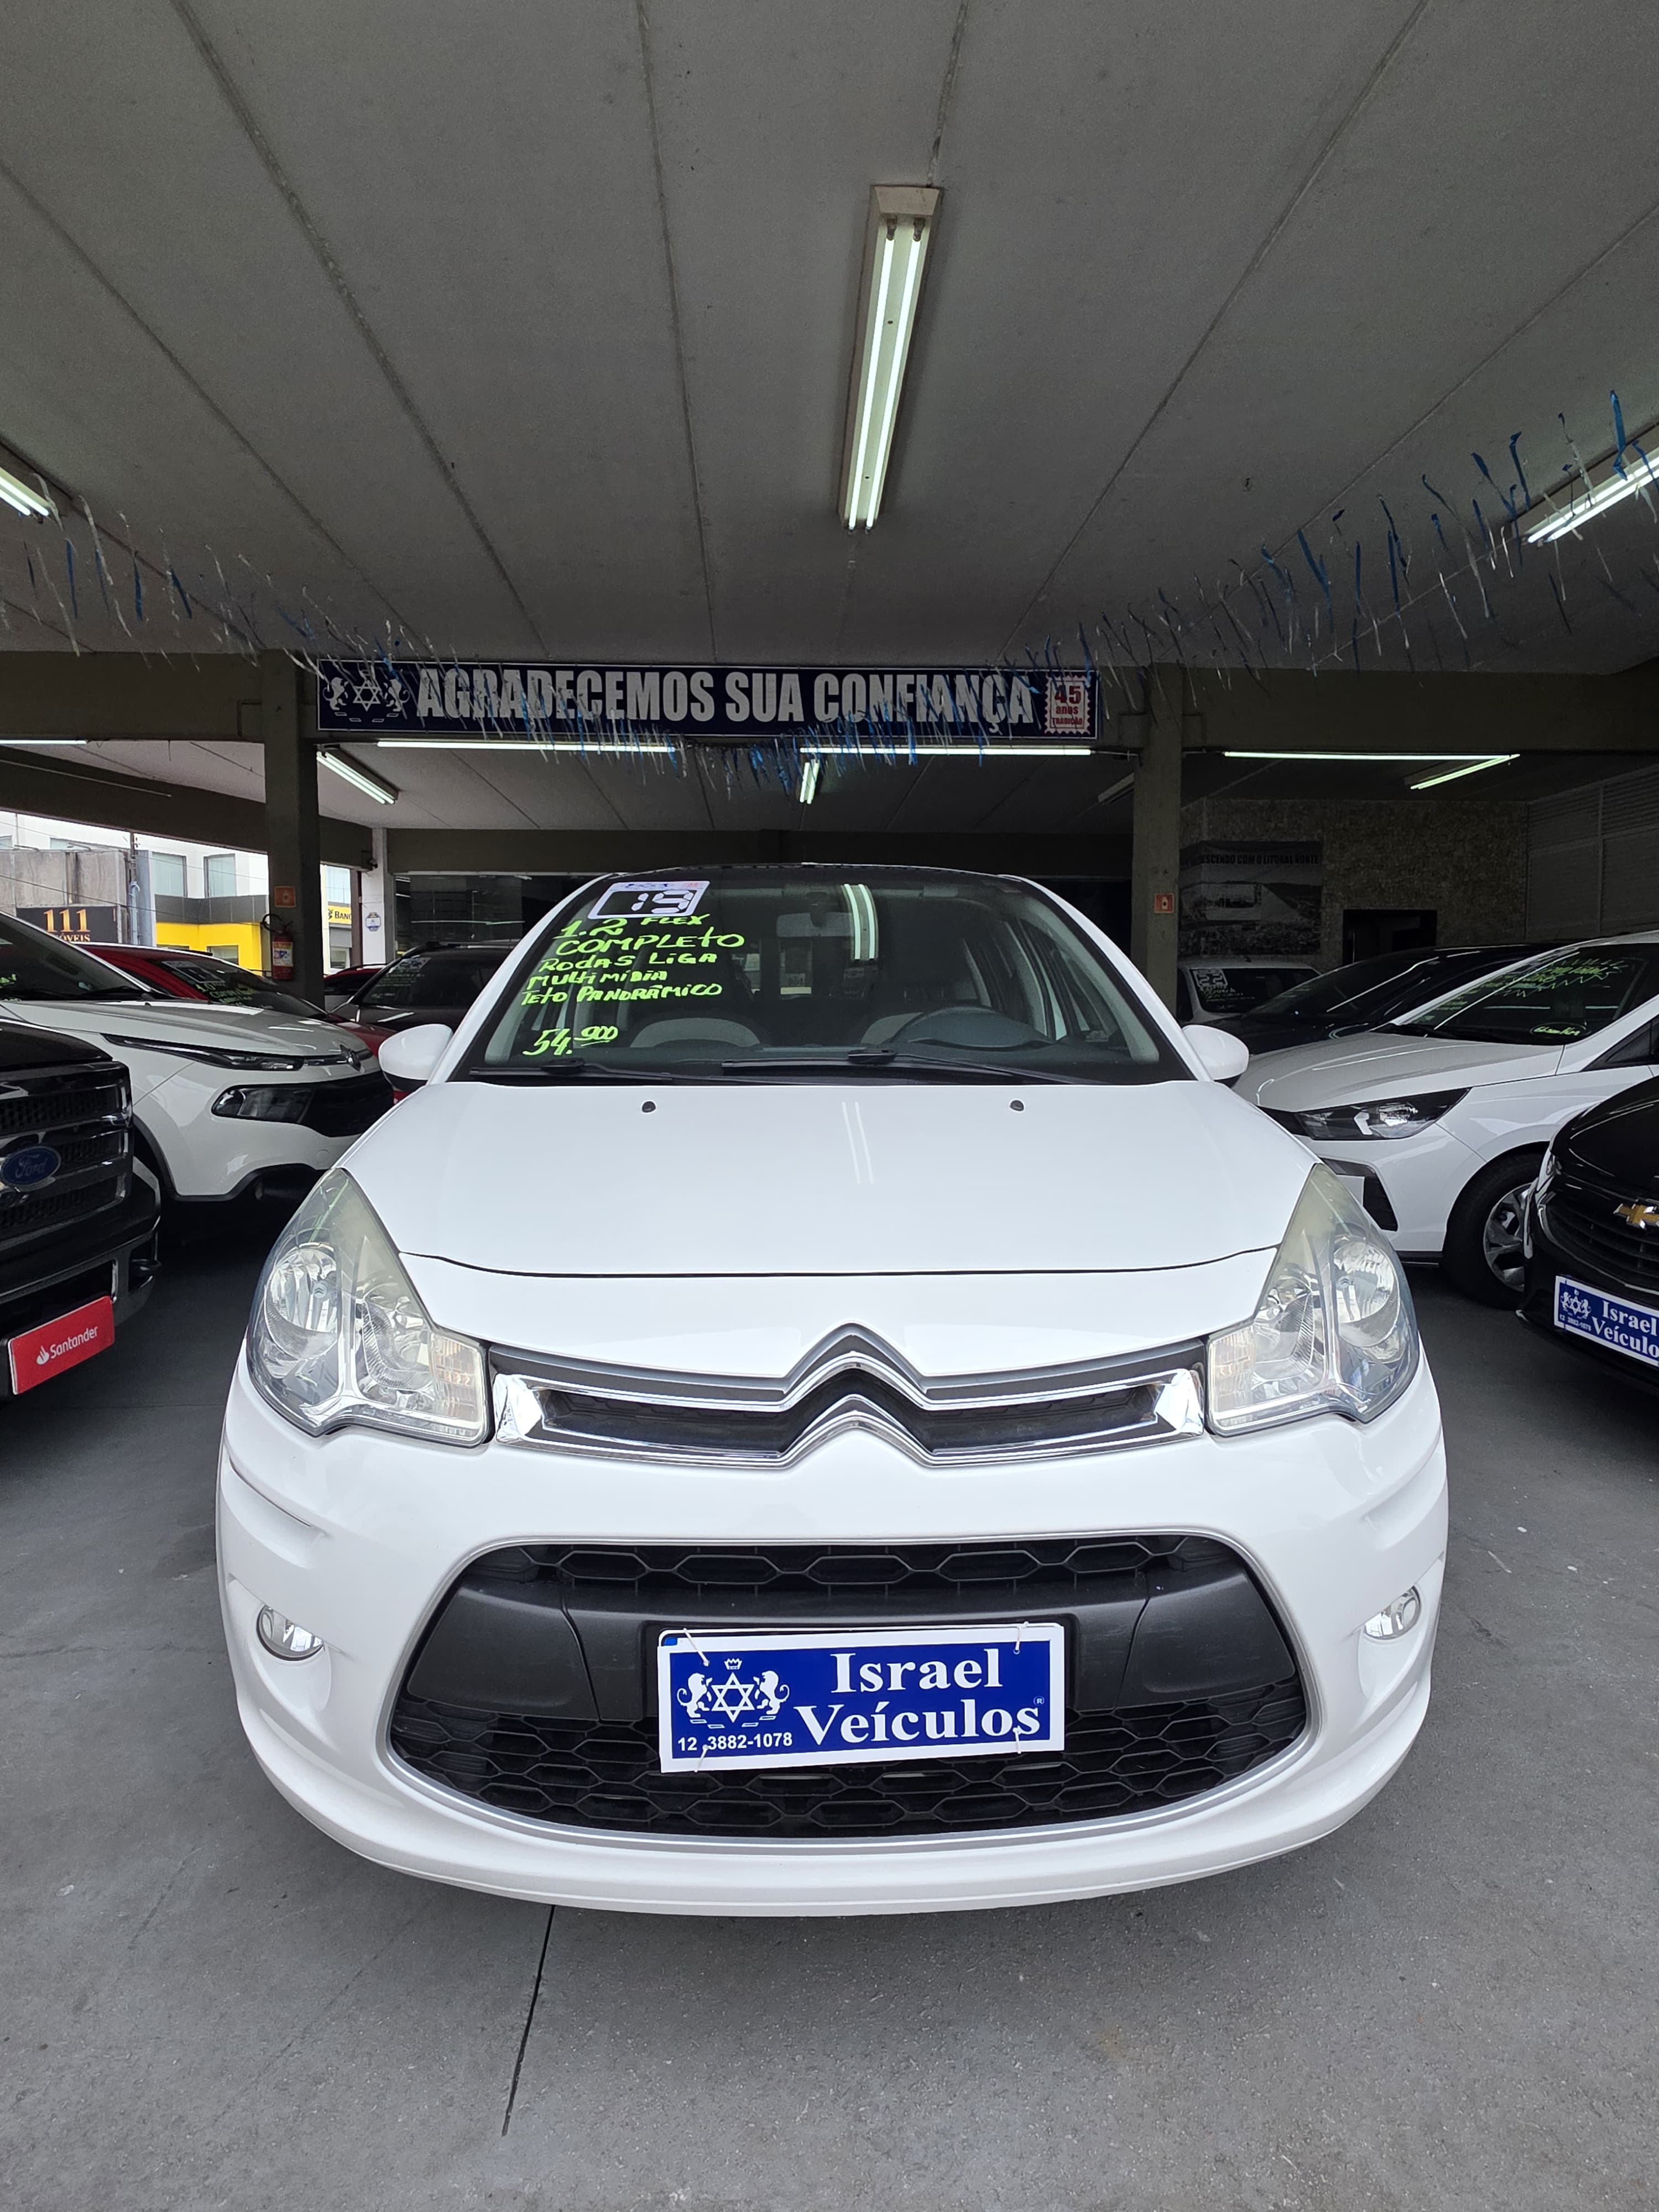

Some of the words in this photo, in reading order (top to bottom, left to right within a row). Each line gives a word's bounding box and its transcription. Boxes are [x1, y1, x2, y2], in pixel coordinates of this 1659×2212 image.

[416, 668, 715, 721] AGRADECEMOS
[725, 672, 804, 722] SUA
[813, 673, 1034, 734] CONFIANÇA
[1055, 685, 1082, 705] 45
[1056, 706, 1078, 715] anos
[1201, 854, 1235, 864] ESCENDO
[631, 890, 694, 914] 19
[43, 909, 91, 932] 111
[553, 917, 627, 938] 1.2
[640, 914, 711, 925] FLEX
[56, 932, 91, 941] ÓVEIS
[15, 1154, 49, 1178] Ford
[1602, 1300, 1657, 1337] Israel
[50, 1326, 98, 1359] Santander
[831, 1648, 1003, 1693] Israel
[794, 1699, 1040, 1745] Veículos
[678, 1738, 697, 1751] 12
[707, 1732, 793, 1749] 3882-1078
